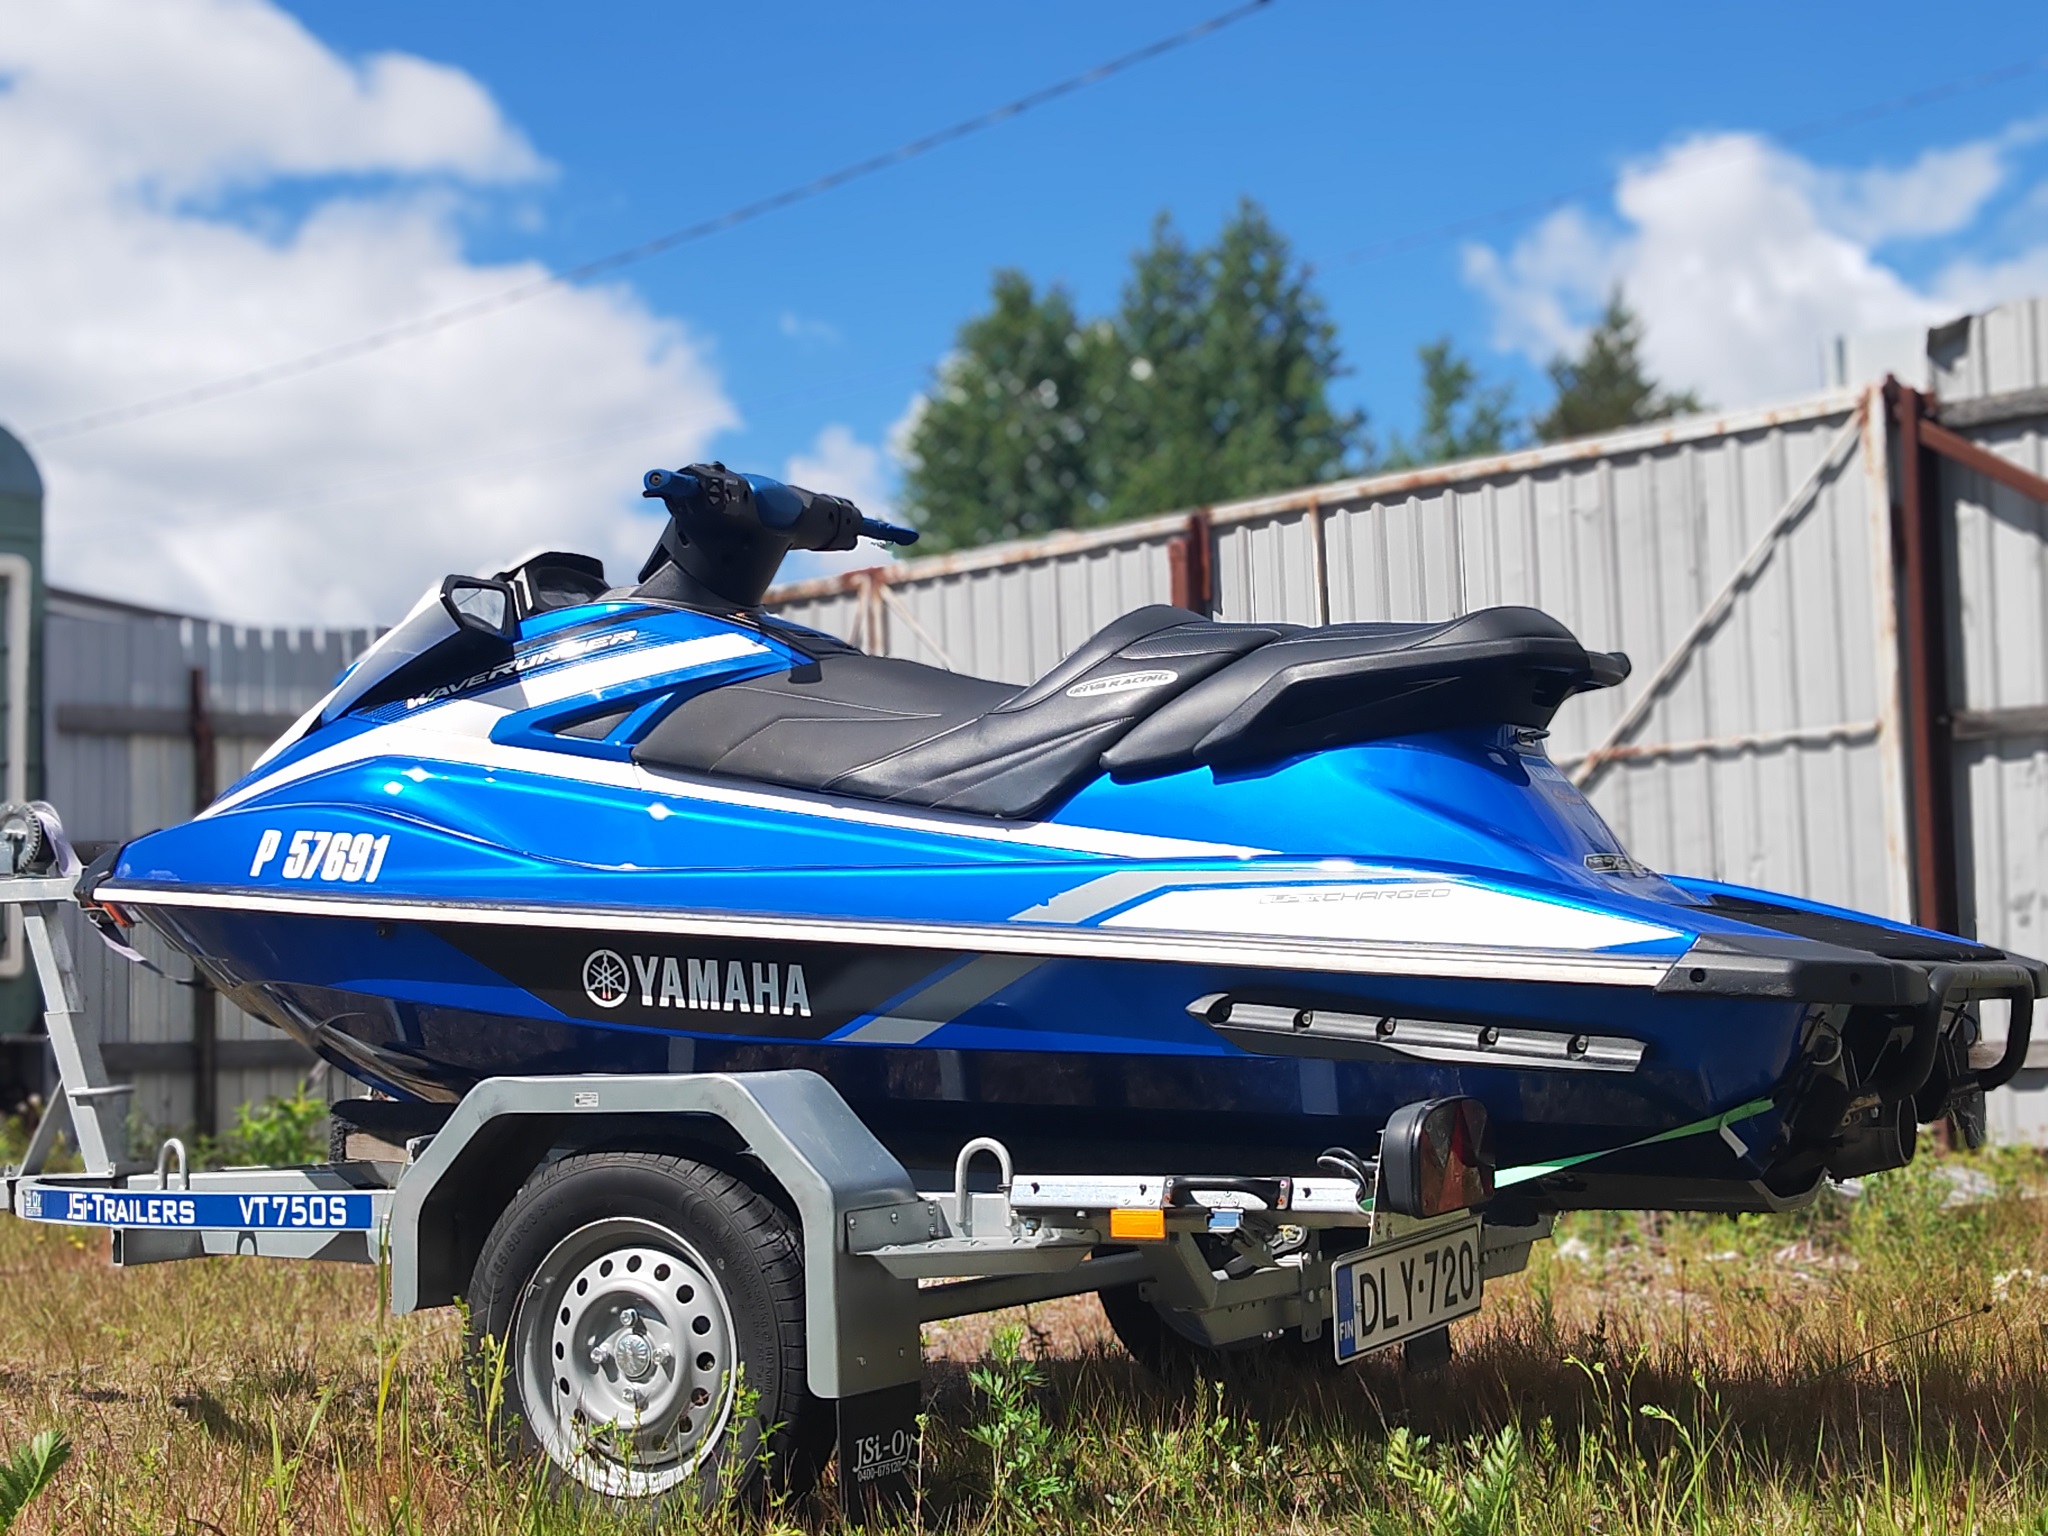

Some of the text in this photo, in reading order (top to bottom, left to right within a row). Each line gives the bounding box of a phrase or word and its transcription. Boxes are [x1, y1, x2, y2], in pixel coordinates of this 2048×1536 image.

[405, 629, 638, 709] WAVERUNER
[1108, 673, 1169, 688] RACING
[249, 829, 391, 883] P 57691
[632, 955, 811, 1017] YAMAHA
[1359, 1240, 1474, 1337] DLY-720
[1339, 1318, 1354, 1342] FIN
